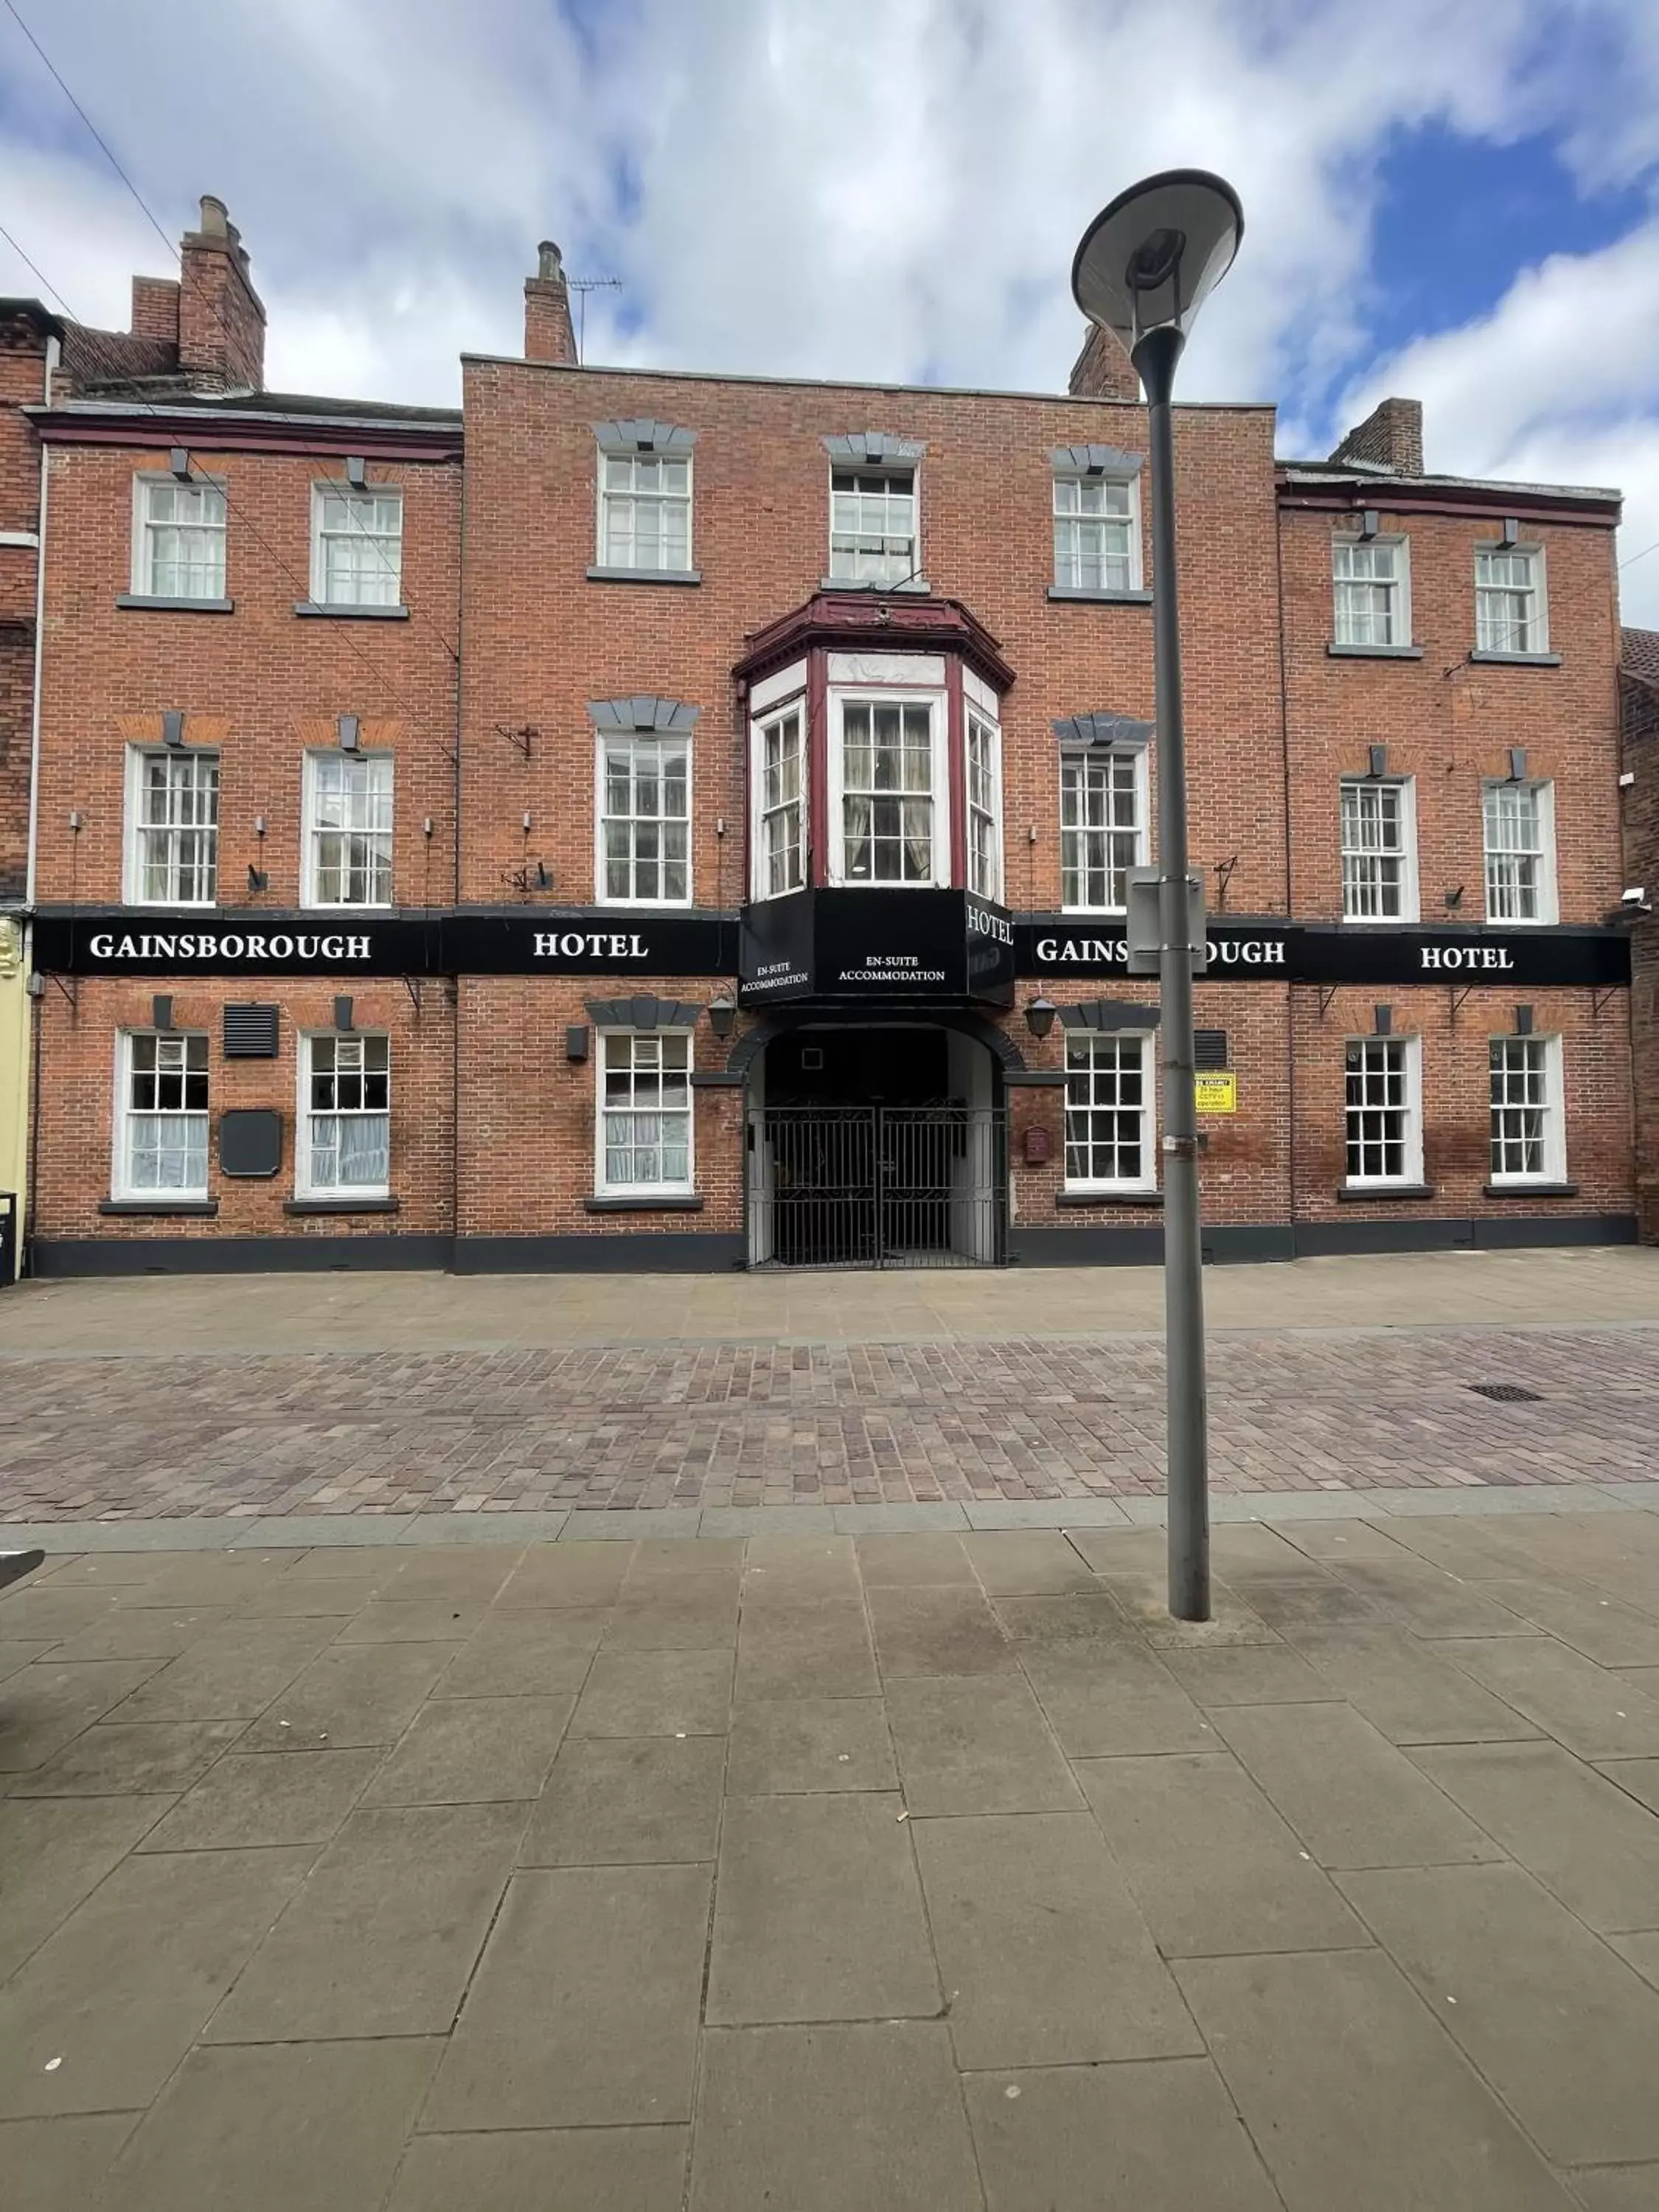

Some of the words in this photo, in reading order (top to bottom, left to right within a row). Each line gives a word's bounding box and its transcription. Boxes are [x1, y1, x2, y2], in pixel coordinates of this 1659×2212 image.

[967, 905, 1013, 945] HOTEL
[90, 935, 371, 958] GAINSBOROUGH
[534, 933, 648, 956] HOTEL
[1037, 938, 1284, 963] GAINSOUGH
[866, 957, 918, 966] EN-SUITE
[1421, 948, 1514, 967] HOTEL
[757, 961, 790, 976] EN-SUITE
[839, 970, 944, 980] ACCOMMODATION
[741, 973, 808, 992] ACCOMMODATION
